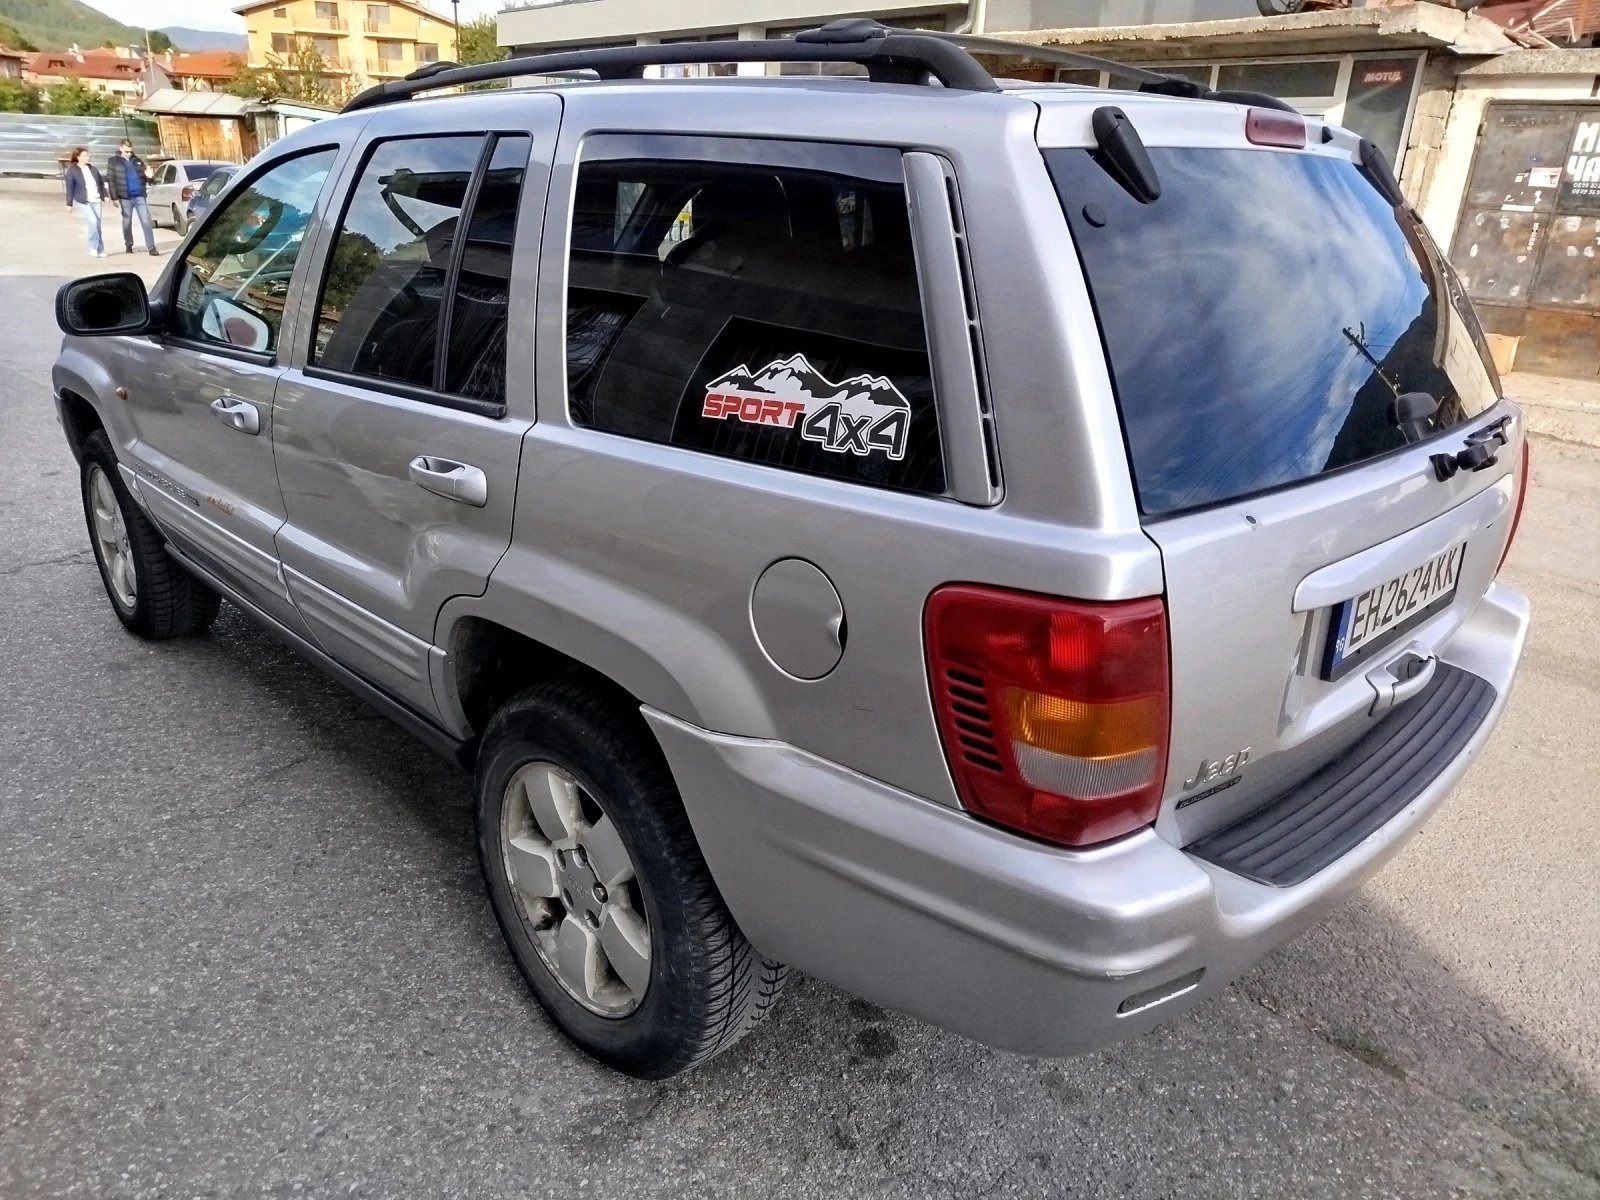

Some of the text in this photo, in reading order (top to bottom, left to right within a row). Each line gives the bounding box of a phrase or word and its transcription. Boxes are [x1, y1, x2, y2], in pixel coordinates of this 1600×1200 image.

[1364, 71, 1401, 82] MOTUL
[1572, 122, 1600, 153] М
[703, 393, 909, 458] SPORT 4x4
[1183, 746, 1252, 791] Jeep
